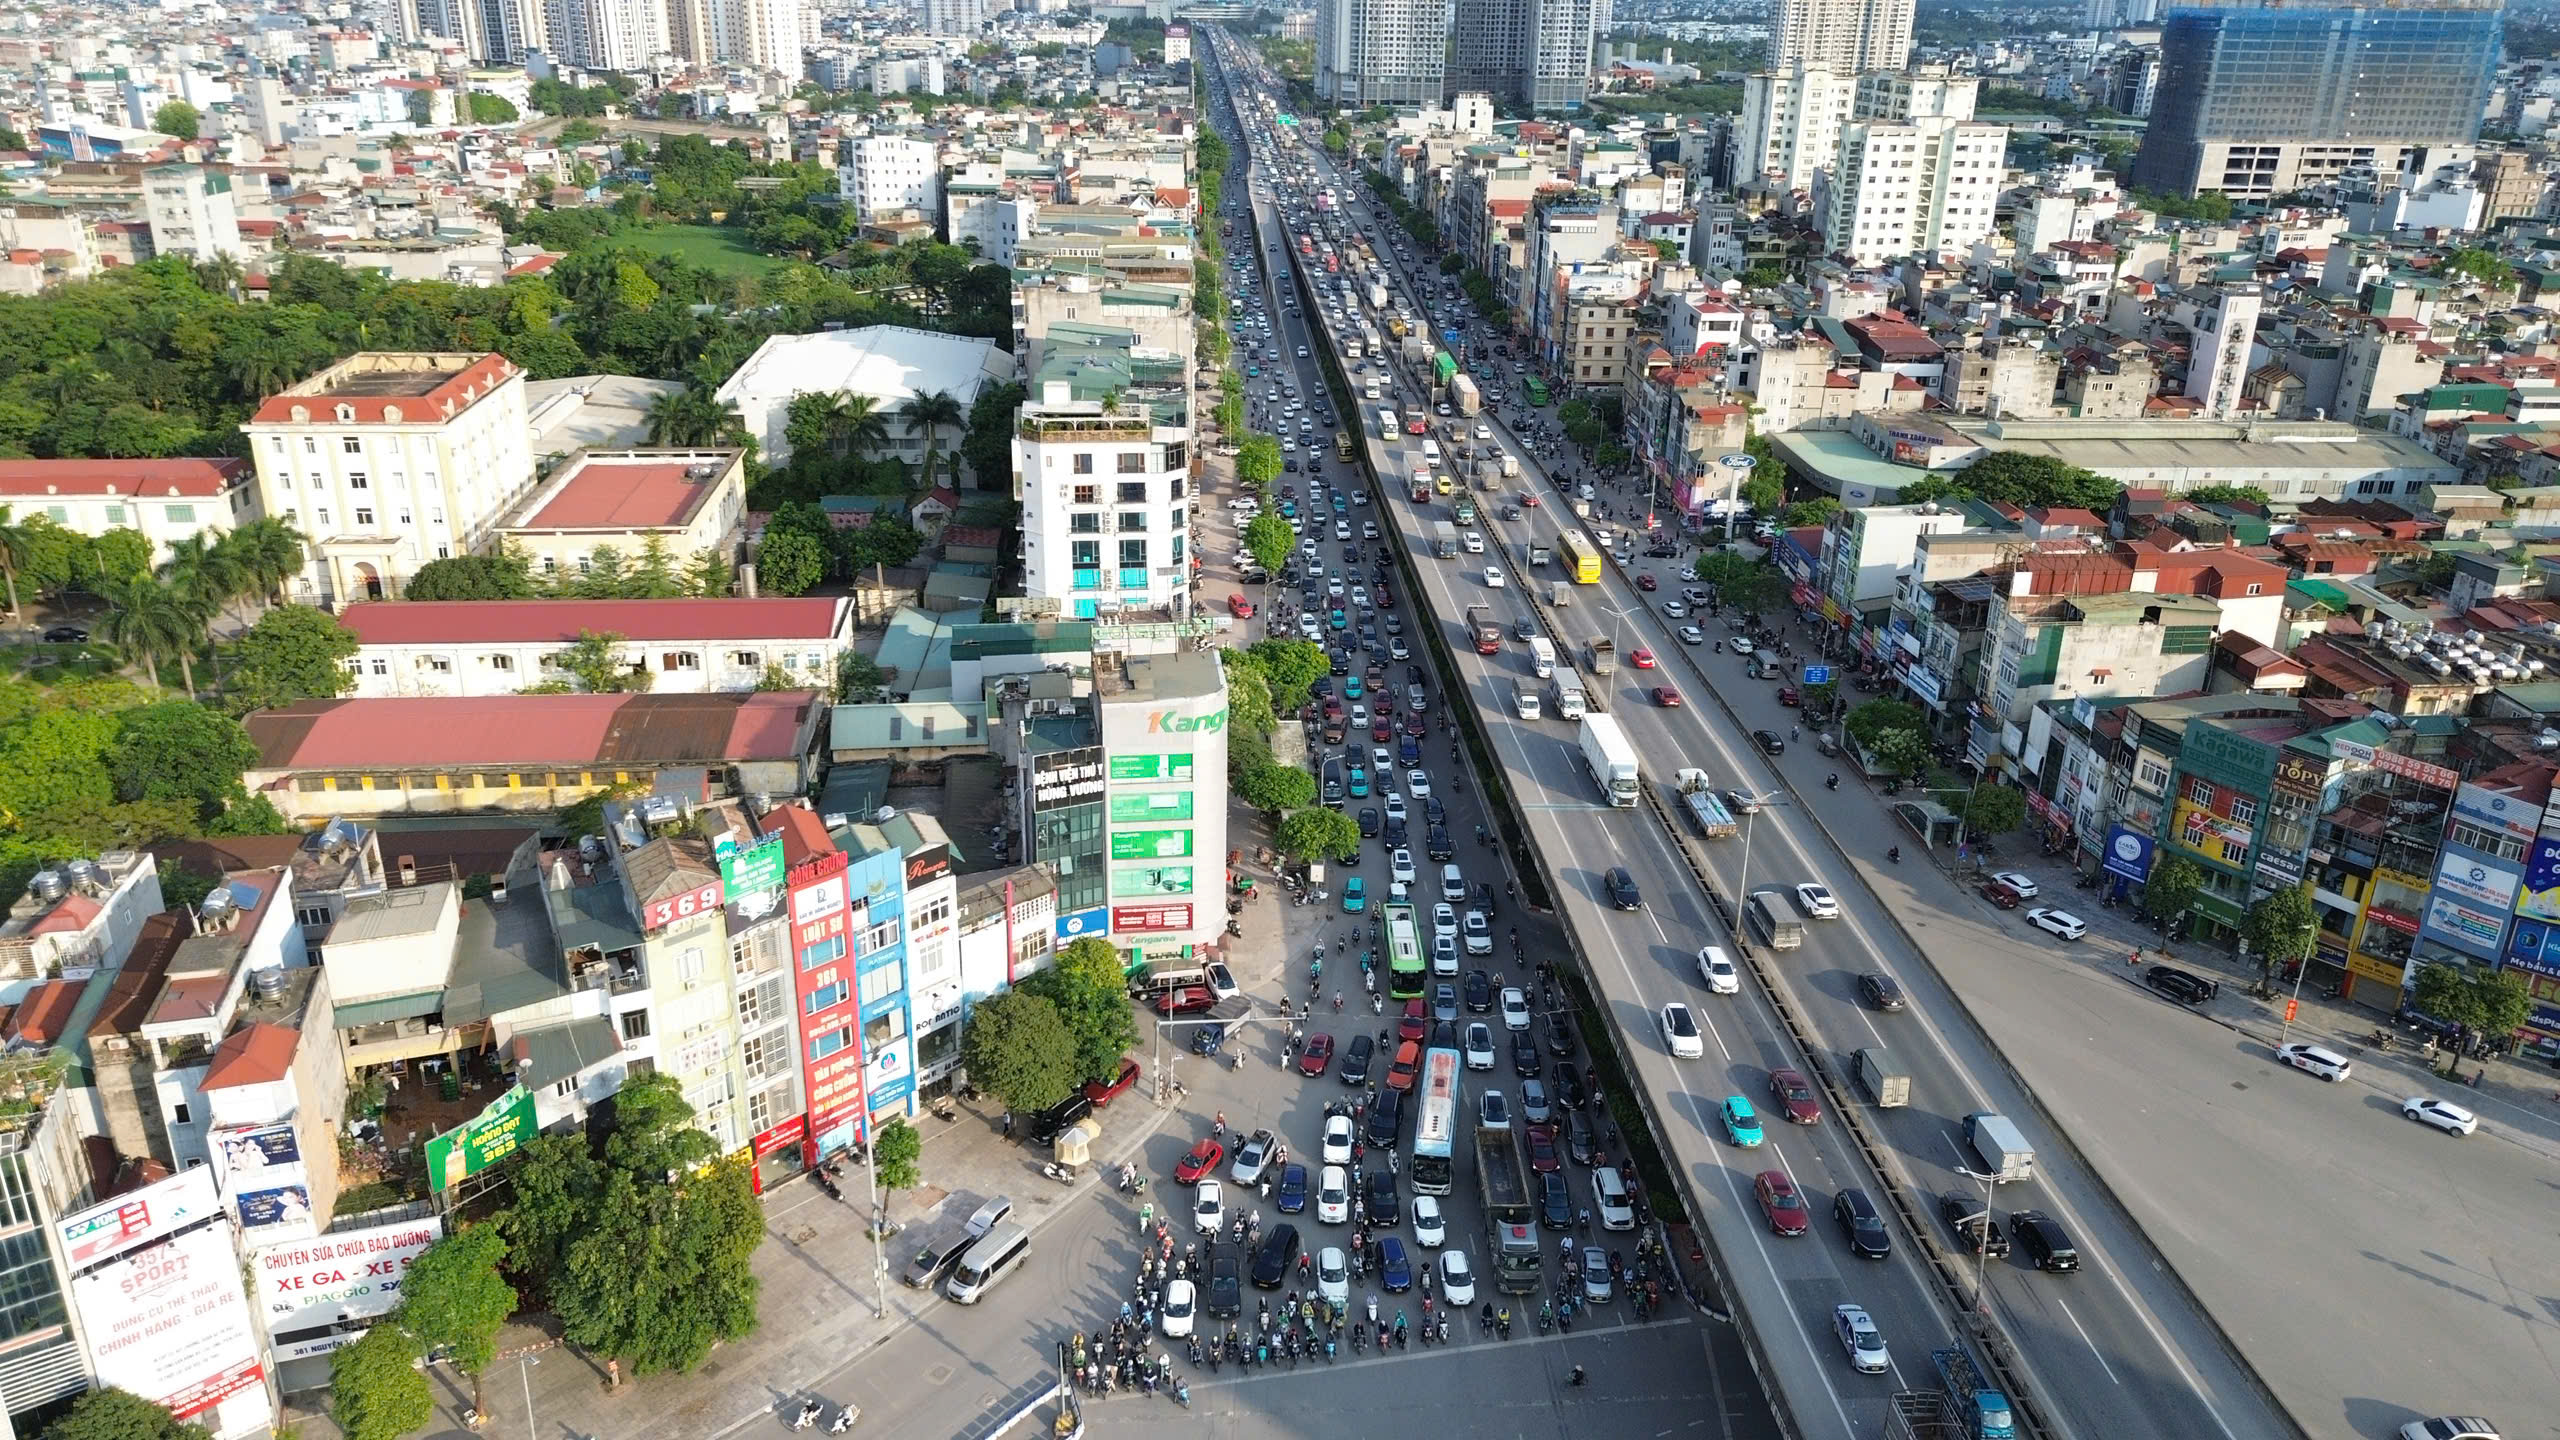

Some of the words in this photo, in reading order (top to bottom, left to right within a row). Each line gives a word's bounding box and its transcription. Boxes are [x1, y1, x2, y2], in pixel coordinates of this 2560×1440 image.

[2336, 742, 2350, 752] RED
[1059, 765, 1079, 784] VIỆN
[2277, 762, 2324, 787] TOPY
[2376, 760, 2402, 773] 0978
[2405, 768, 2418, 778] 91
[2422, 773, 2435, 783] 70
[2438, 777, 2452, 788] 75
[2378, 751, 2404, 765] 0988
[2407, 760, 2421, 769] 59
[2423, 765, 2437, 775] 55
[2440, 769, 2454, 780] 66
[2259, 851, 2301, 872] caesar
[656, 887, 717, 924] 369
[803, 921, 826, 944] LUẬT
[2510, 957, 2526, 968] Mẹ
[2547, 966, 2555, 976] &
[503, 1116, 520, 1133] ĐẠT
[120, 1254, 190, 1294] SPORT
[277, 1276, 305, 1293] XE
[312, 1270, 345, 1285] GA
[367, 1260, 395, 1277] XE
[303, 1286, 370, 1305] PIAGGIO
[380, 1280, 402, 1292] SY
[294, 1347, 309, 1356] 381
